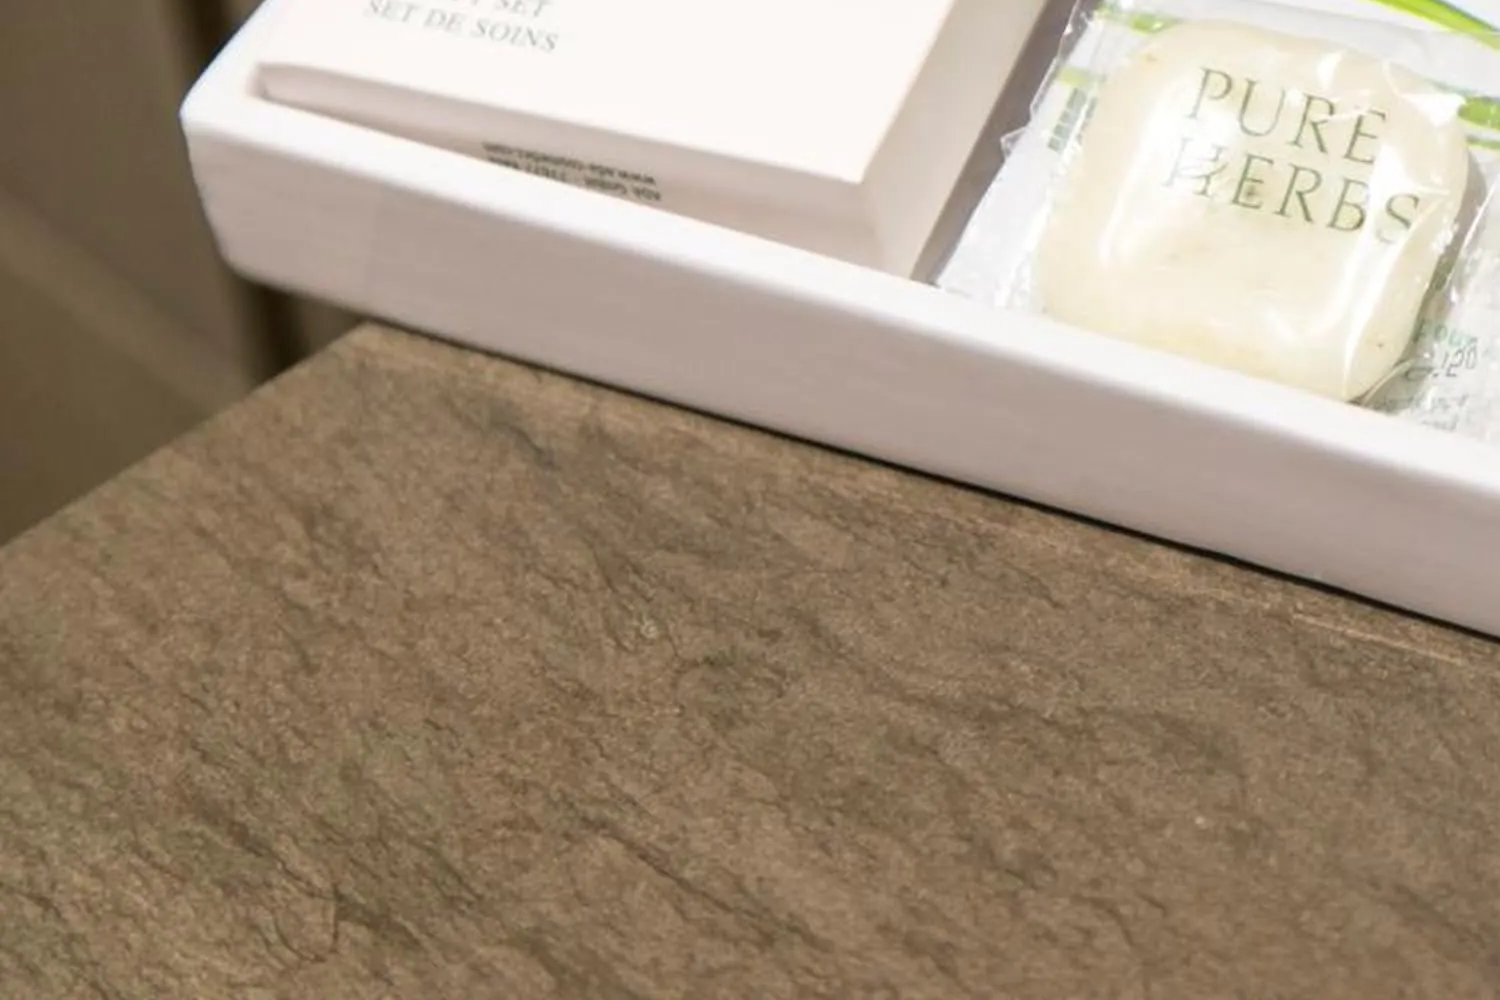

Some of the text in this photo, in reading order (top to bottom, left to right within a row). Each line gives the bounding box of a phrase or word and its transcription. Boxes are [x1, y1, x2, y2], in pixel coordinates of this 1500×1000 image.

[424, 8, 465, 32] DE
[472, 18, 559, 53] SOINS
[1187, 66, 1387, 165] PURE
[1161, 137, 1420, 245] HERBS
